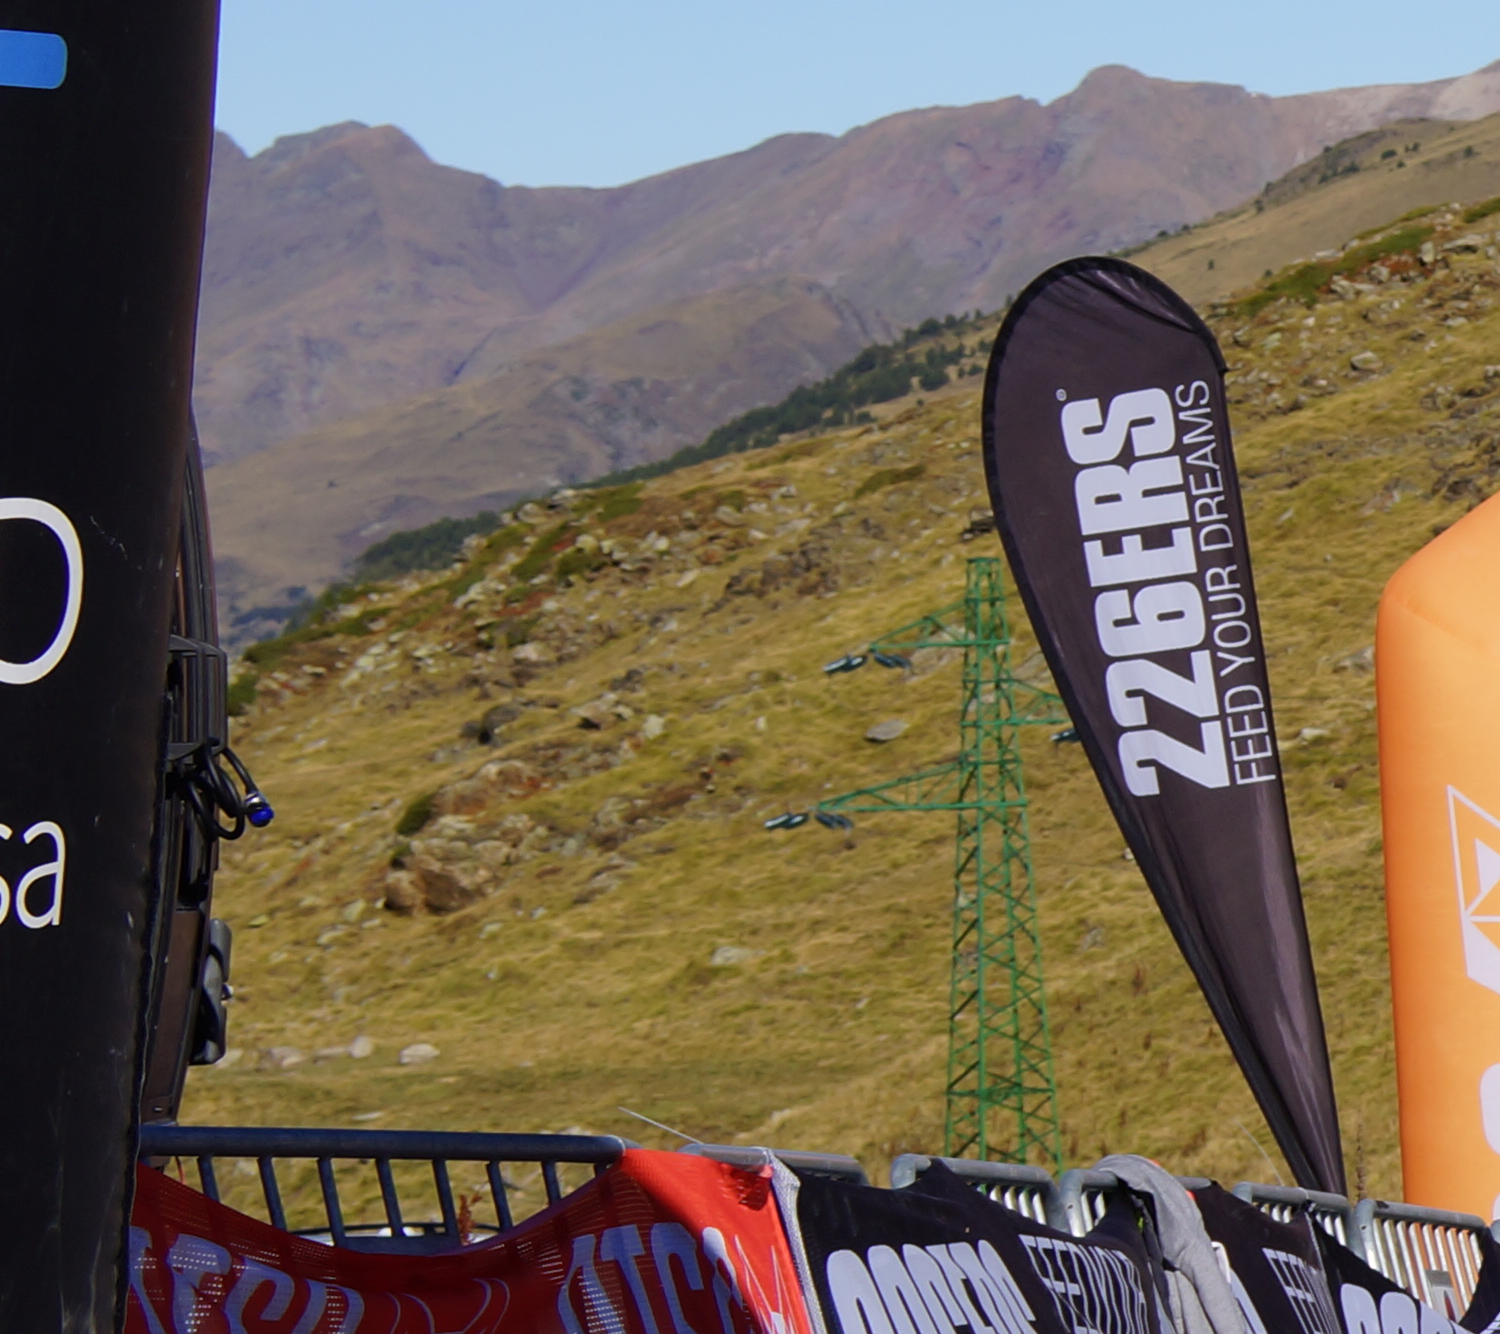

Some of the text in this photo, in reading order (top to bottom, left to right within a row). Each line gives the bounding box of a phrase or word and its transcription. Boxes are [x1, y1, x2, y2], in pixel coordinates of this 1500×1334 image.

[1060, 387, 1232, 798] 226ERS
[1174, 379, 1277, 787] FEED YOUR DREAMS
